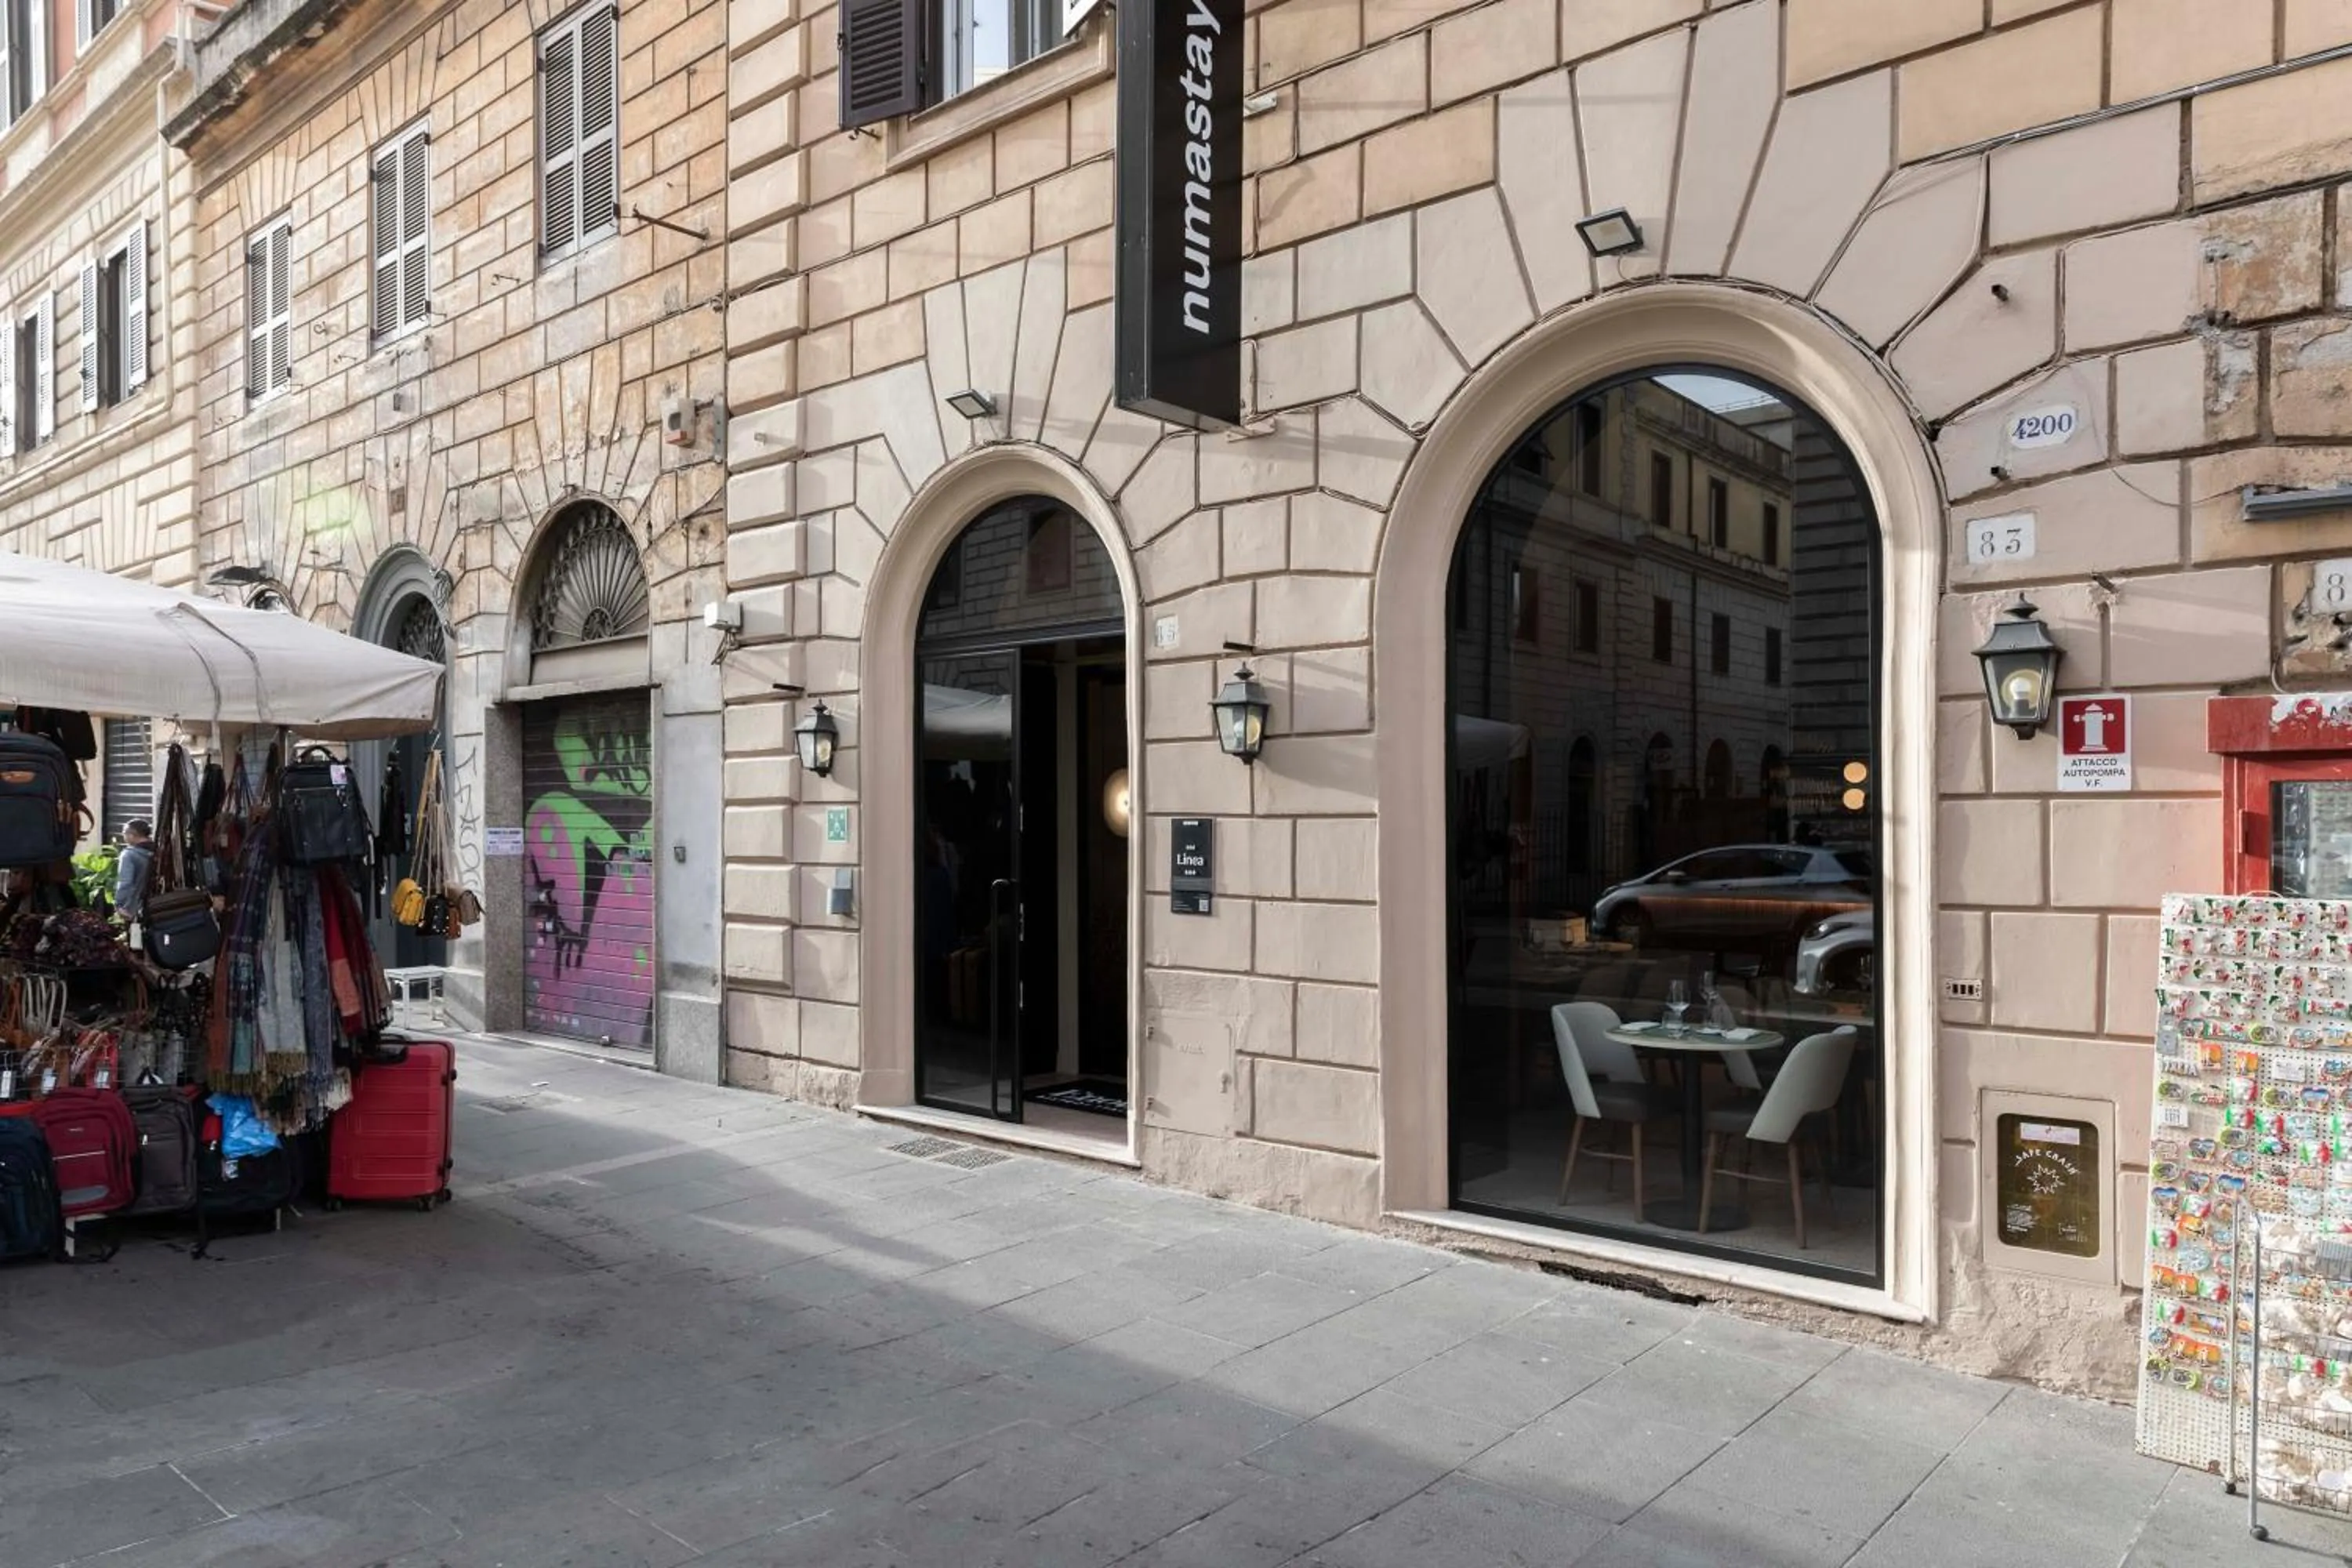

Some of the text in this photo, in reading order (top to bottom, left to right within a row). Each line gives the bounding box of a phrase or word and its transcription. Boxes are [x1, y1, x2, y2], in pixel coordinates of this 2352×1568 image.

[1180, 0, 1221, 334] numastay
[2012, 413, 2072, 439] 4200
[1980, 528, 2021, 558] 83
[2071, 758, 2117, 767] ATTACCO
[2063, 768, 2125, 777] AUTOPOMPA
[1177, 853, 1203, 866] Linea
